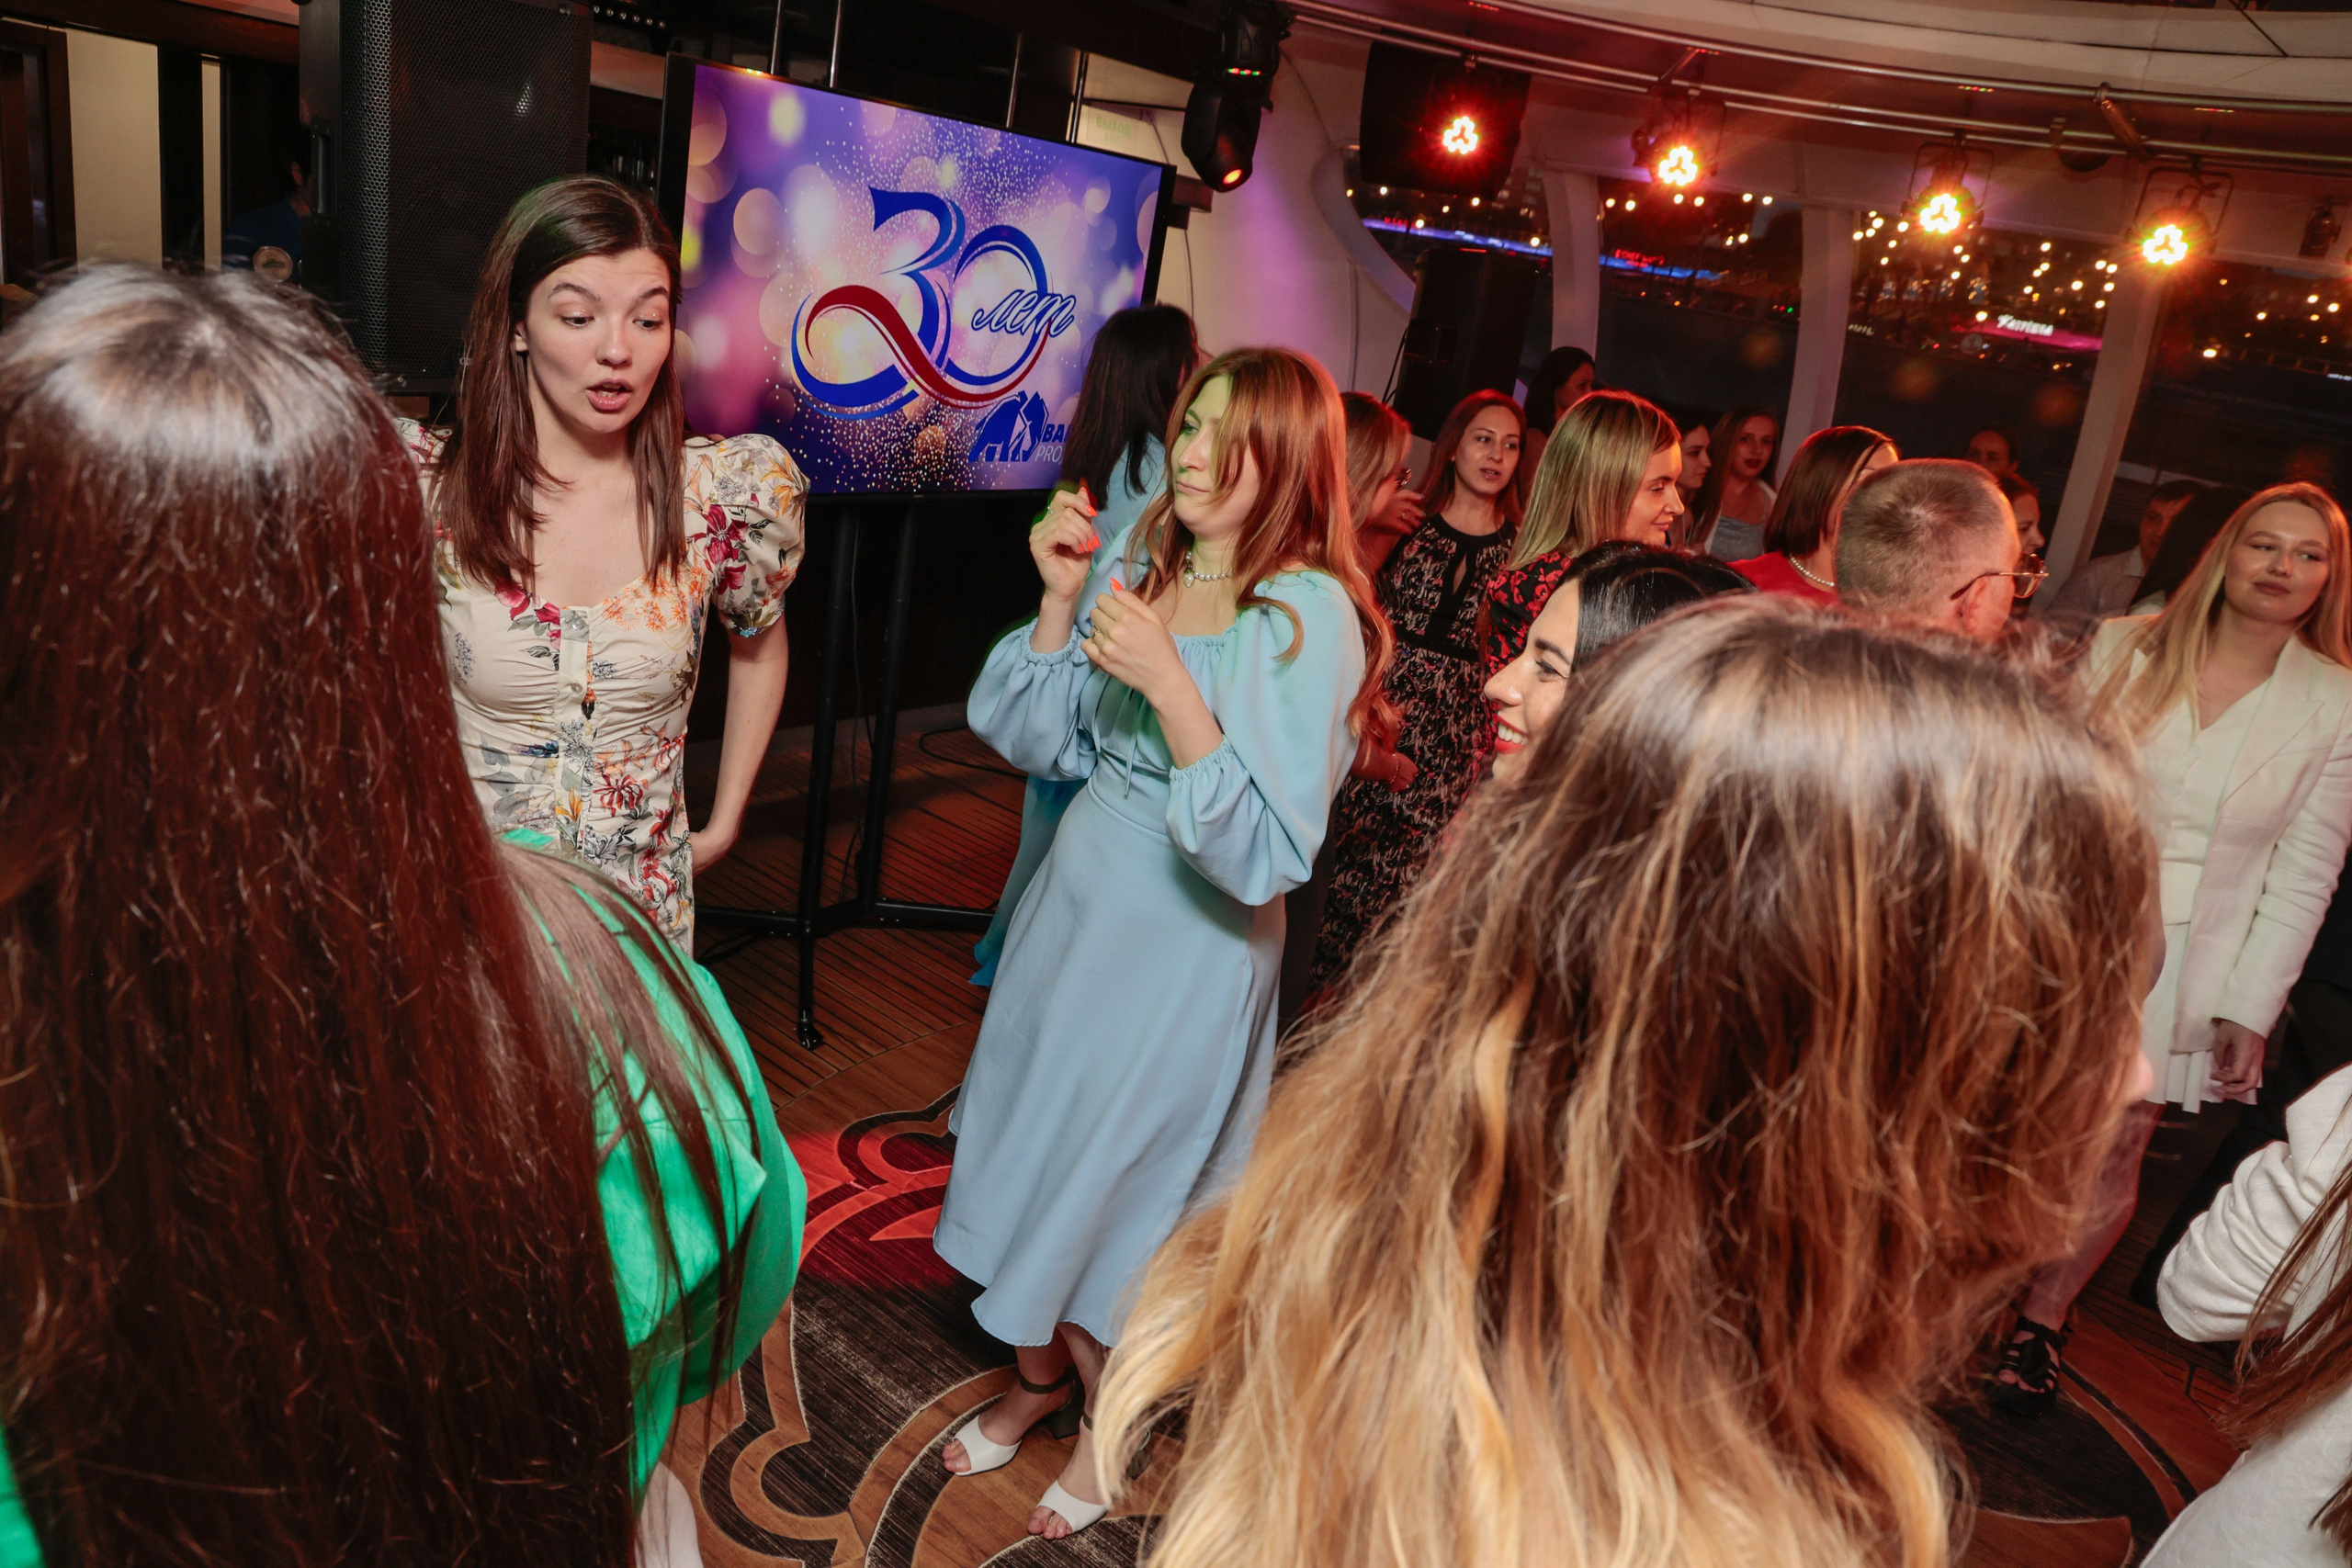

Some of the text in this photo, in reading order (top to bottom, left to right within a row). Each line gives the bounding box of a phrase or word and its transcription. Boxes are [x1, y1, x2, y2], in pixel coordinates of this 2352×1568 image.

[791, 186, 1076, 420] 30 лет
[1035, 446, 1063, 465] PRO
